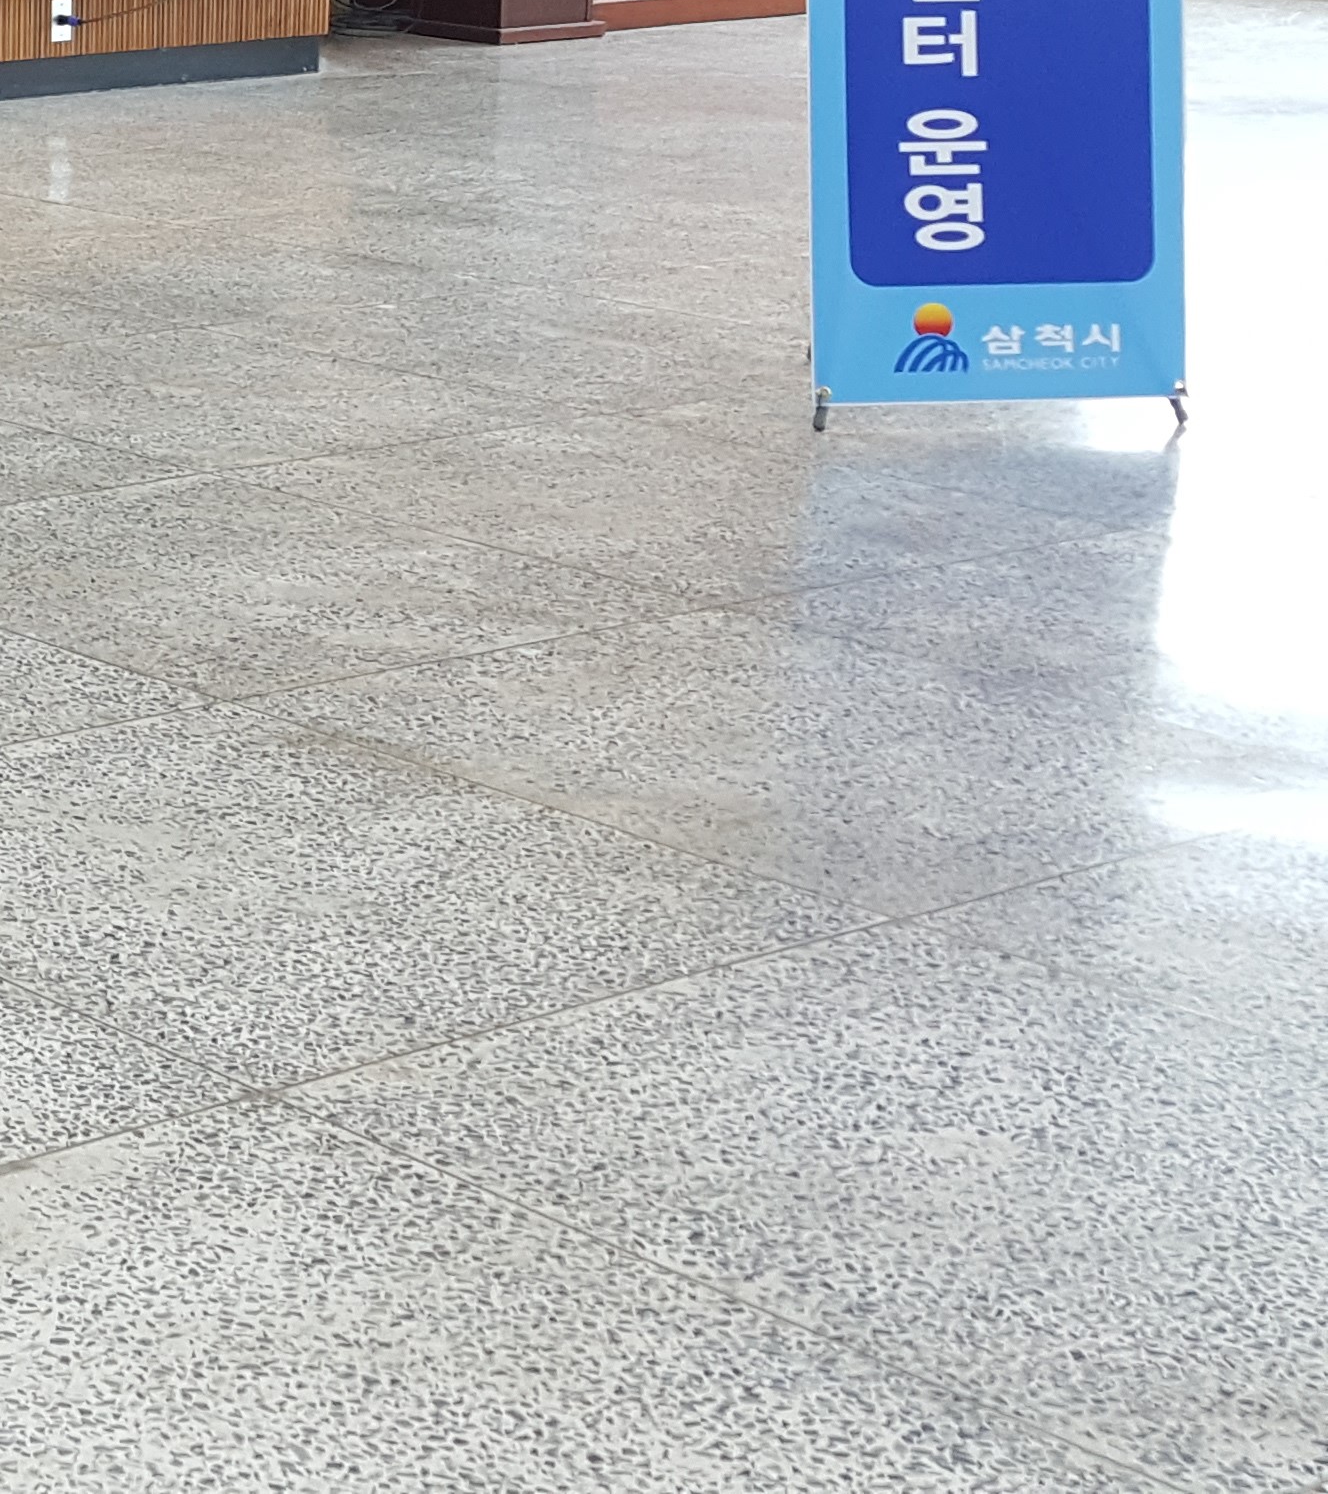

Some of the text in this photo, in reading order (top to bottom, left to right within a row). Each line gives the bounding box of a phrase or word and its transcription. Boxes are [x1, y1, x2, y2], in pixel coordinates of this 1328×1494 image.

[898, 108, 987, 251] 운영
[981, 323, 1121, 355] 삼척시
[1080, 356, 1121, 370] CITY
